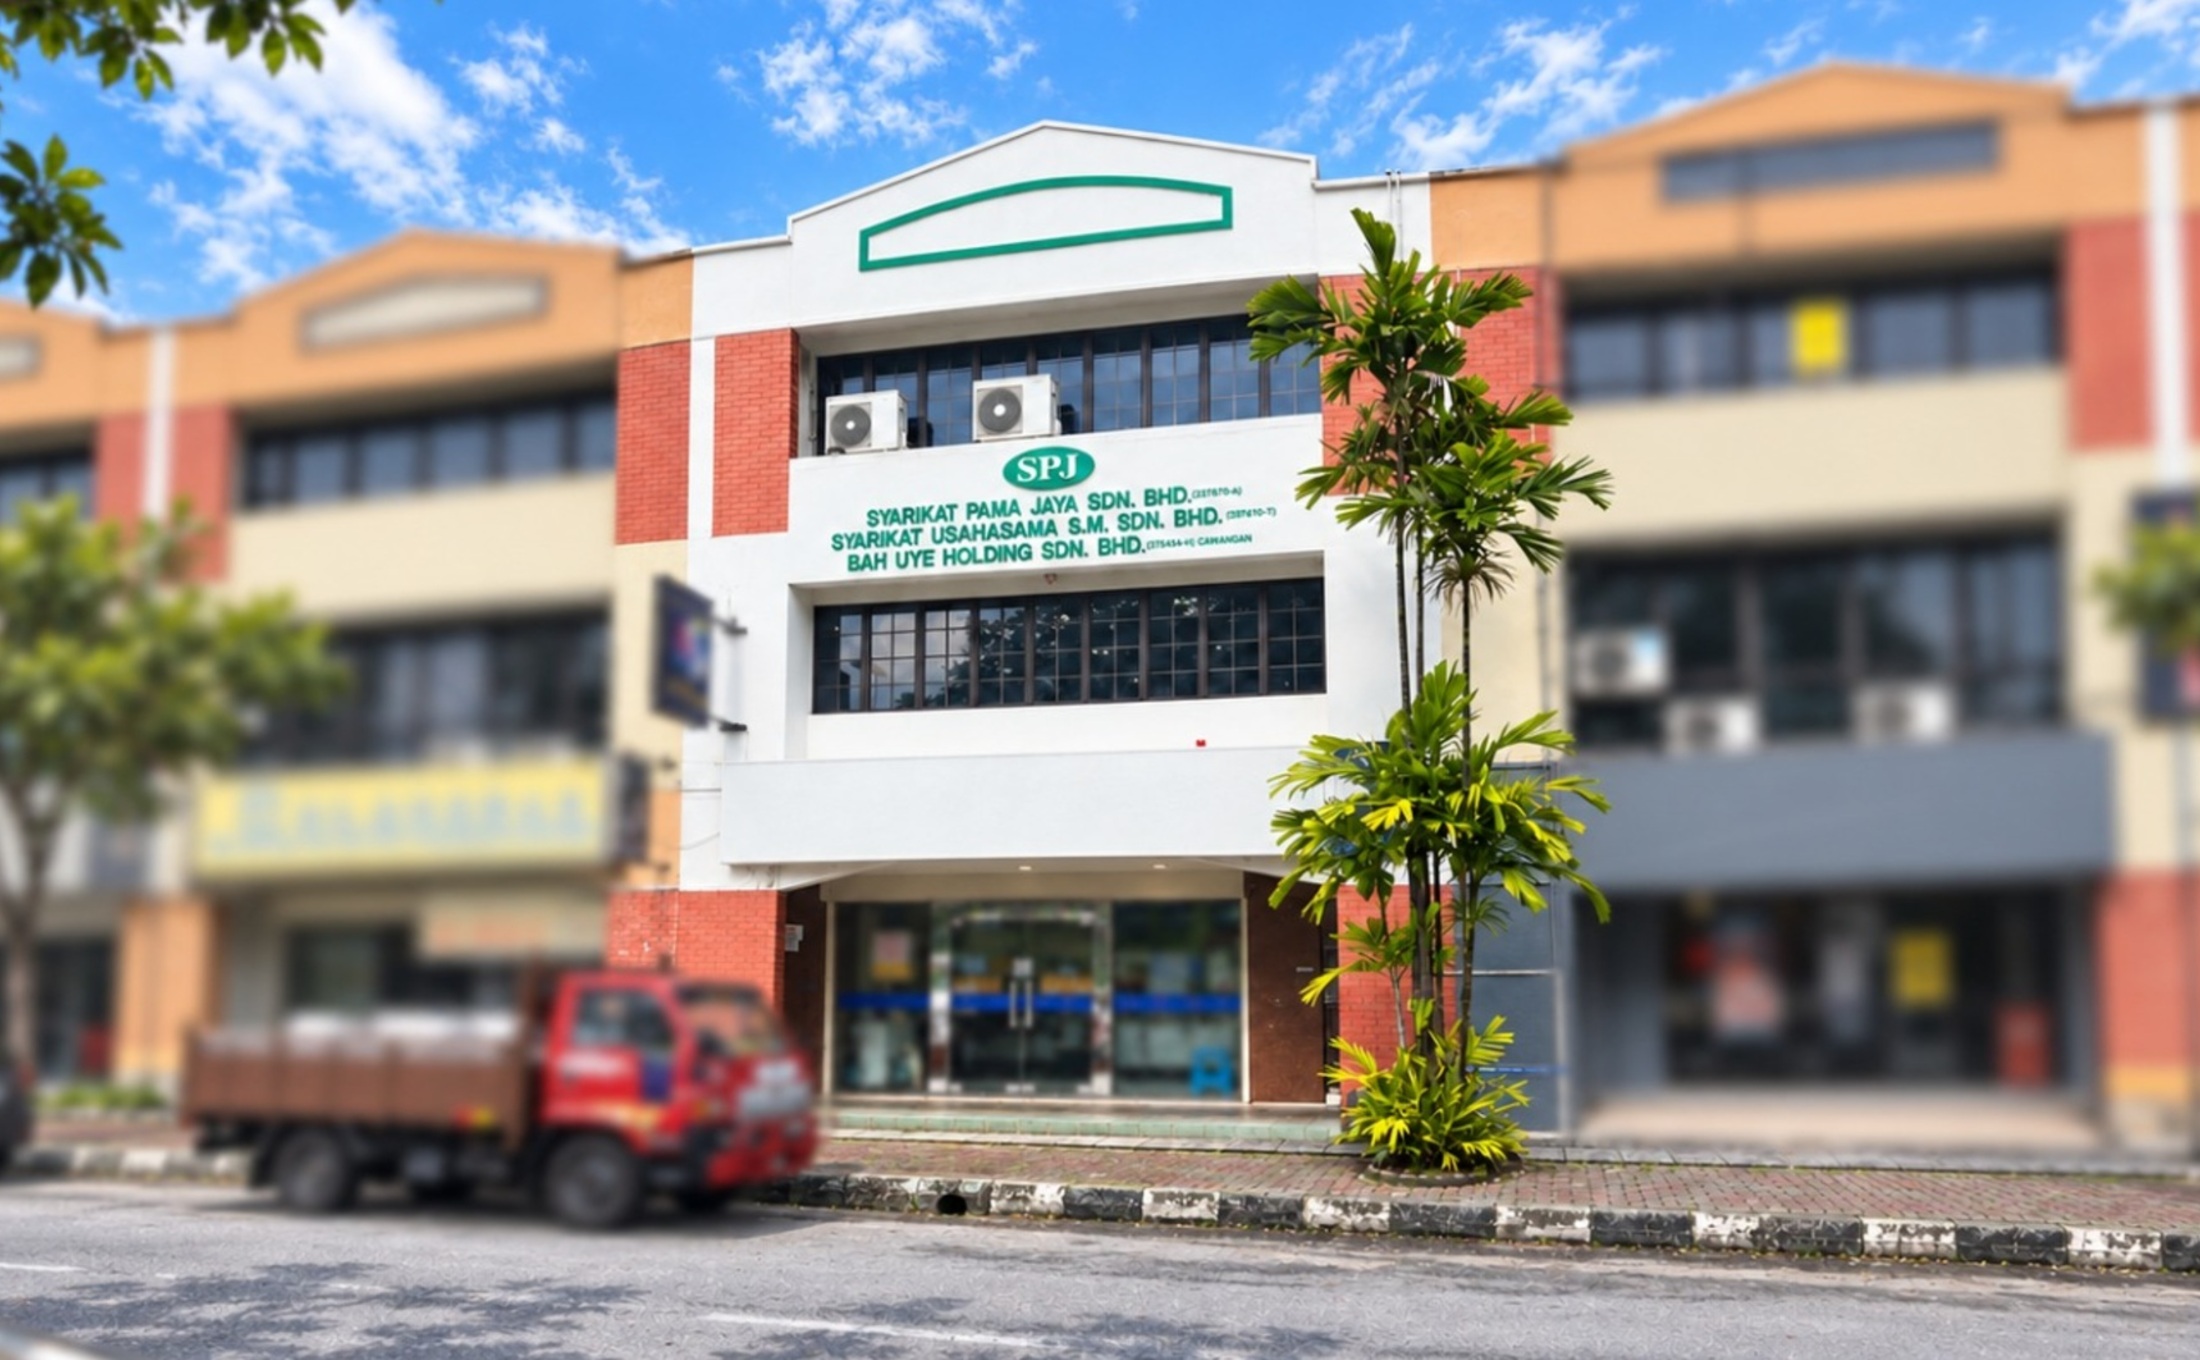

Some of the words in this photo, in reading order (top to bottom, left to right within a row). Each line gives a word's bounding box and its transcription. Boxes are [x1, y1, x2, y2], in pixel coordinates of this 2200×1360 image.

[1017, 453, 1078, 482] SPJ
[866, 503, 958, 527] SYARIKAT
[966, 498, 1021, 519] PAMA
[1031, 496, 1078, 515] JAYA
[1087, 491, 1136, 511] SDN.
[1143, 485, 1192, 507] BHD.
[831, 527, 922, 552] SYARIKAT
[931, 519, 1058, 545] USAHASAMA
[1068, 513, 1110, 535] S.M.
[1117, 510, 1165, 532] SDN.
[1173, 506, 1223, 527] BHD.
[847, 554, 887, 572] BAH
[895, 549, 935, 569] UYE
[942, 542, 1033, 565] HOLDING
[1042, 540, 1089, 560] SDN.
[1098, 534, 1146, 557] BHD.
[1197, 533, 1253, 546] CAWANGAN
